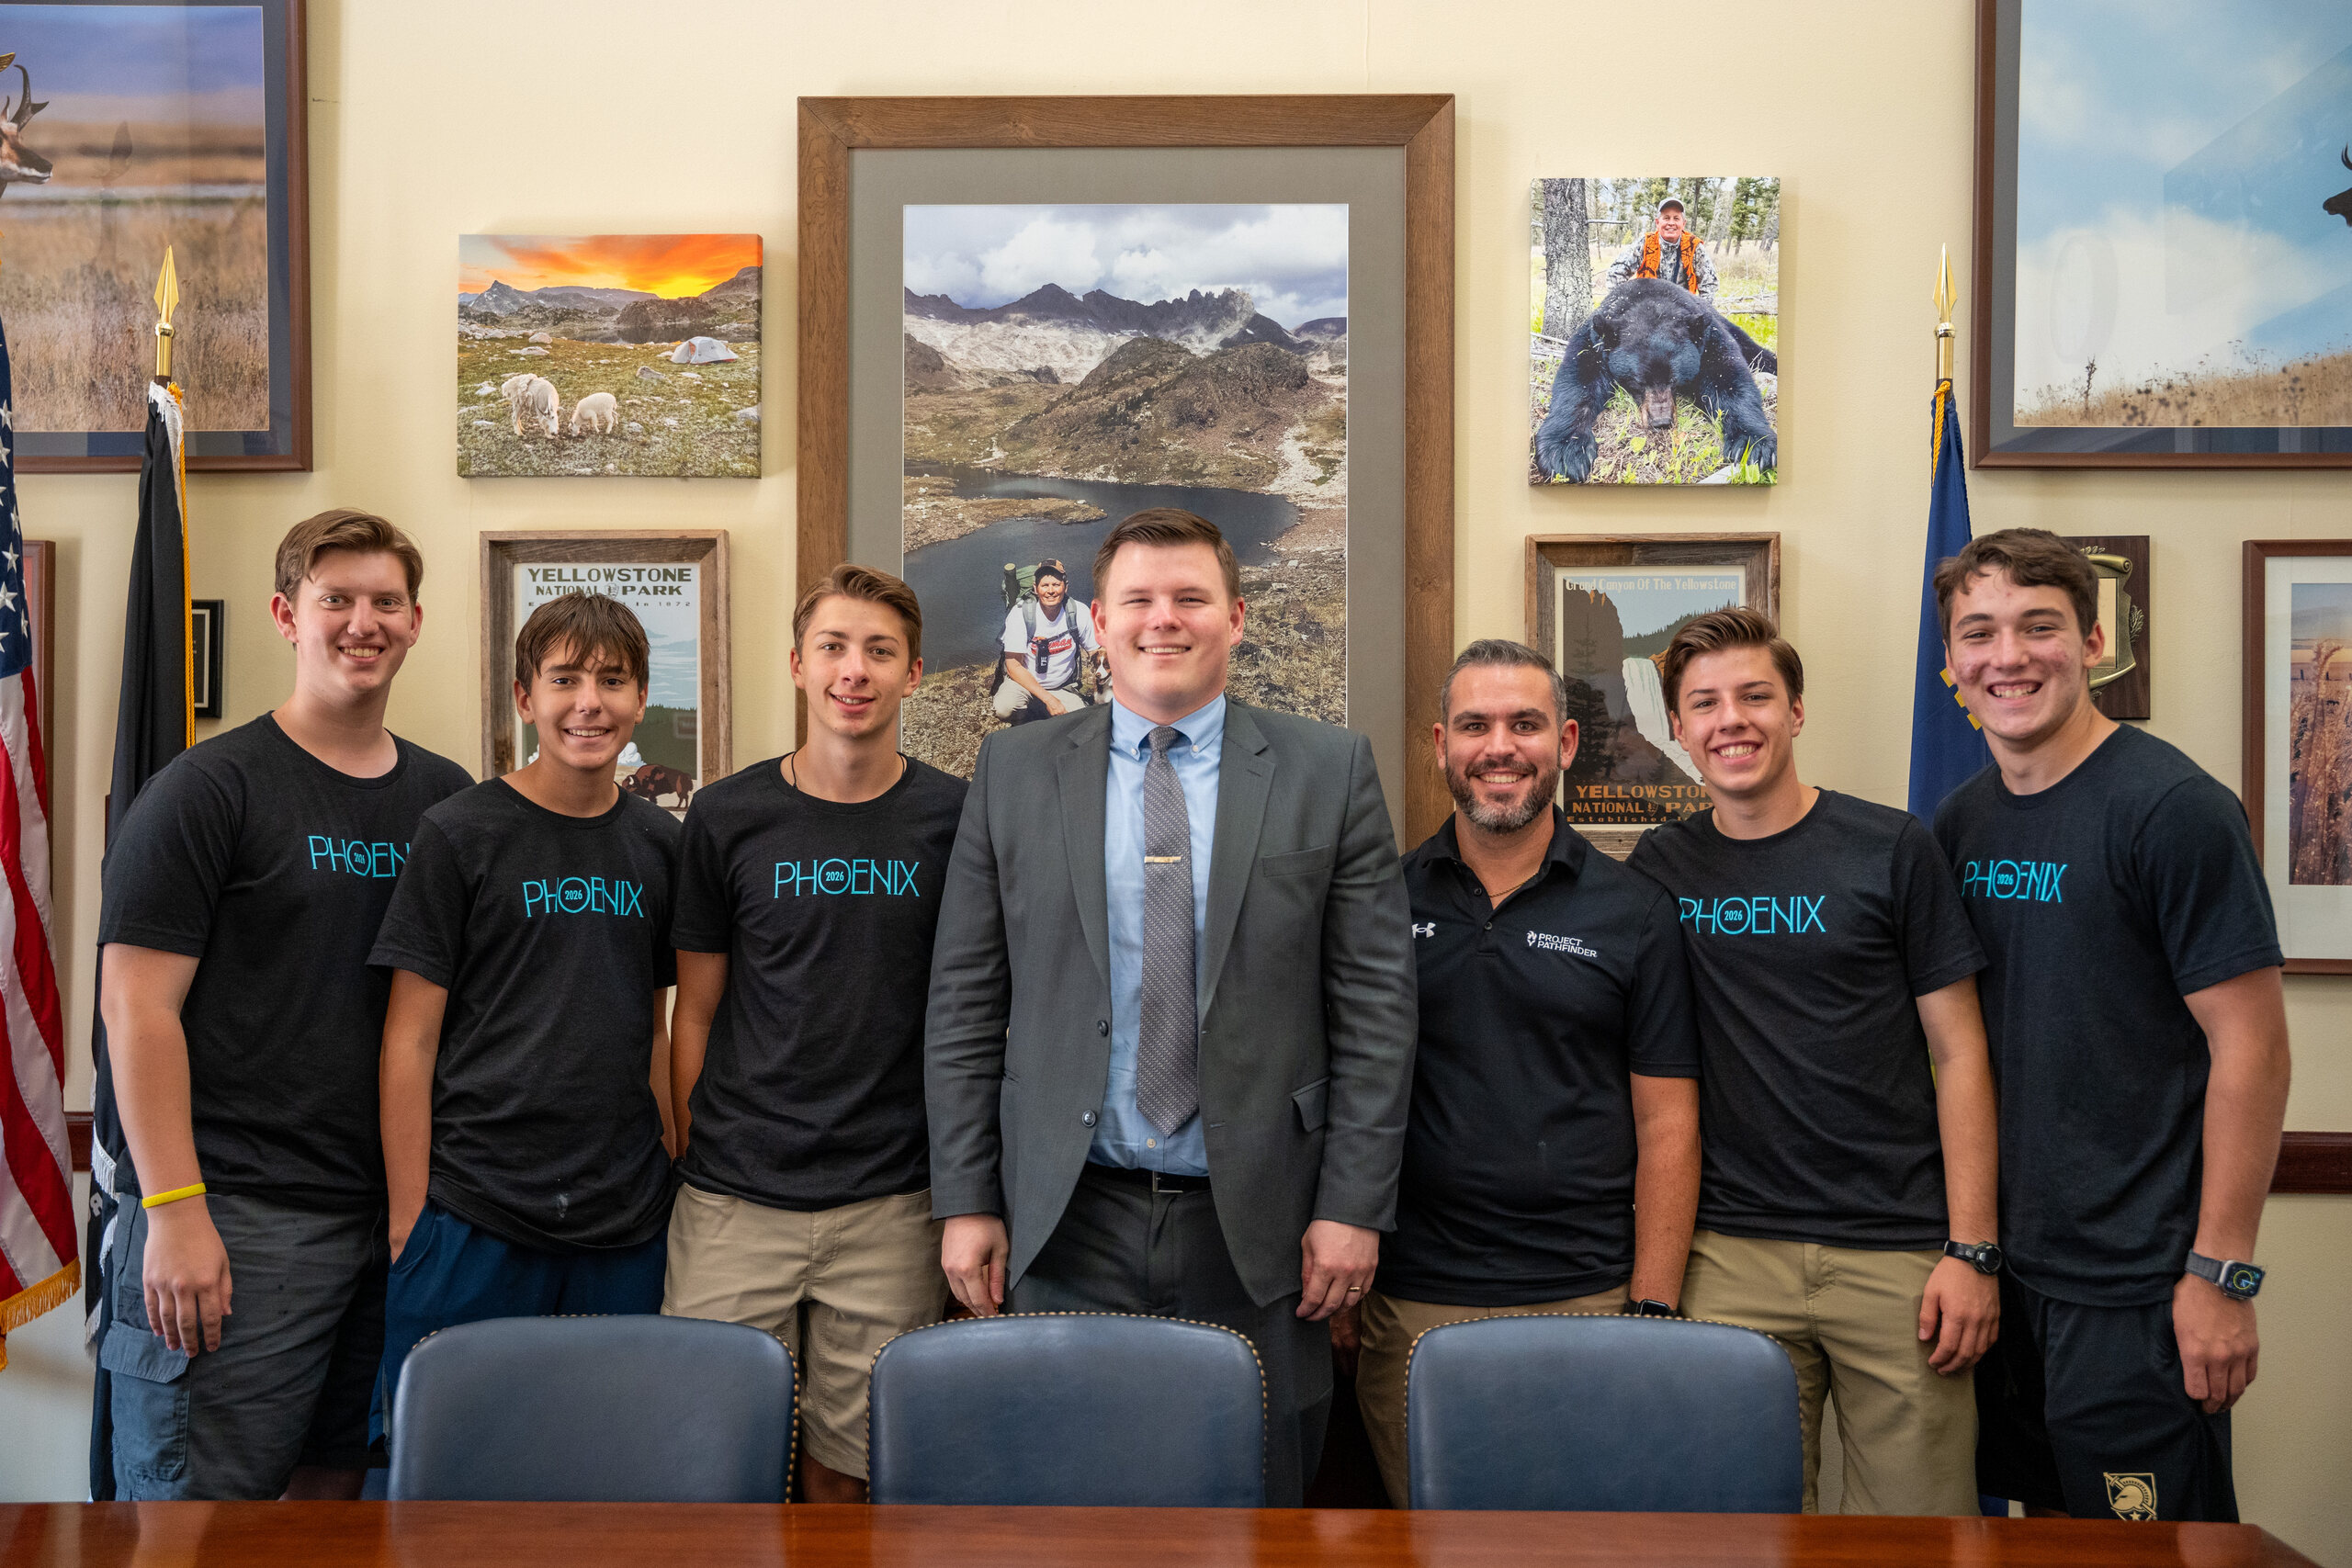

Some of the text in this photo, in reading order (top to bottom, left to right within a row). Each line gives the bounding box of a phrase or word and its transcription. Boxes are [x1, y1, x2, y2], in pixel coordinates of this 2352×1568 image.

[528, 569, 691, 581] YELLOWSTONE
[536, 585, 683, 596] NATIONAL PARK
[1566, 578, 1736, 592] Grand Canyon Of The Yellowstone
[1572, 802, 1713, 813] NATIONAL PAR
[308, 835, 410, 877] PHOEN
[774, 858, 920, 898] PHOENIX
[825, 871, 844, 882] 2026
[1962, 860, 2067, 902] PHOENIX
[1996, 874, 2014, 885] 2026
[522, 876, 644, 918] PHOENIX
[564, 889, 583, 900] 2026
[1679, 895, 1826, 935] PHOENIX
[1724, 910, 1743, 921] 2026
[1538, 933, 1583, 946] PROJECT
[1537, 941, 1598, 958] PATHFINDER
